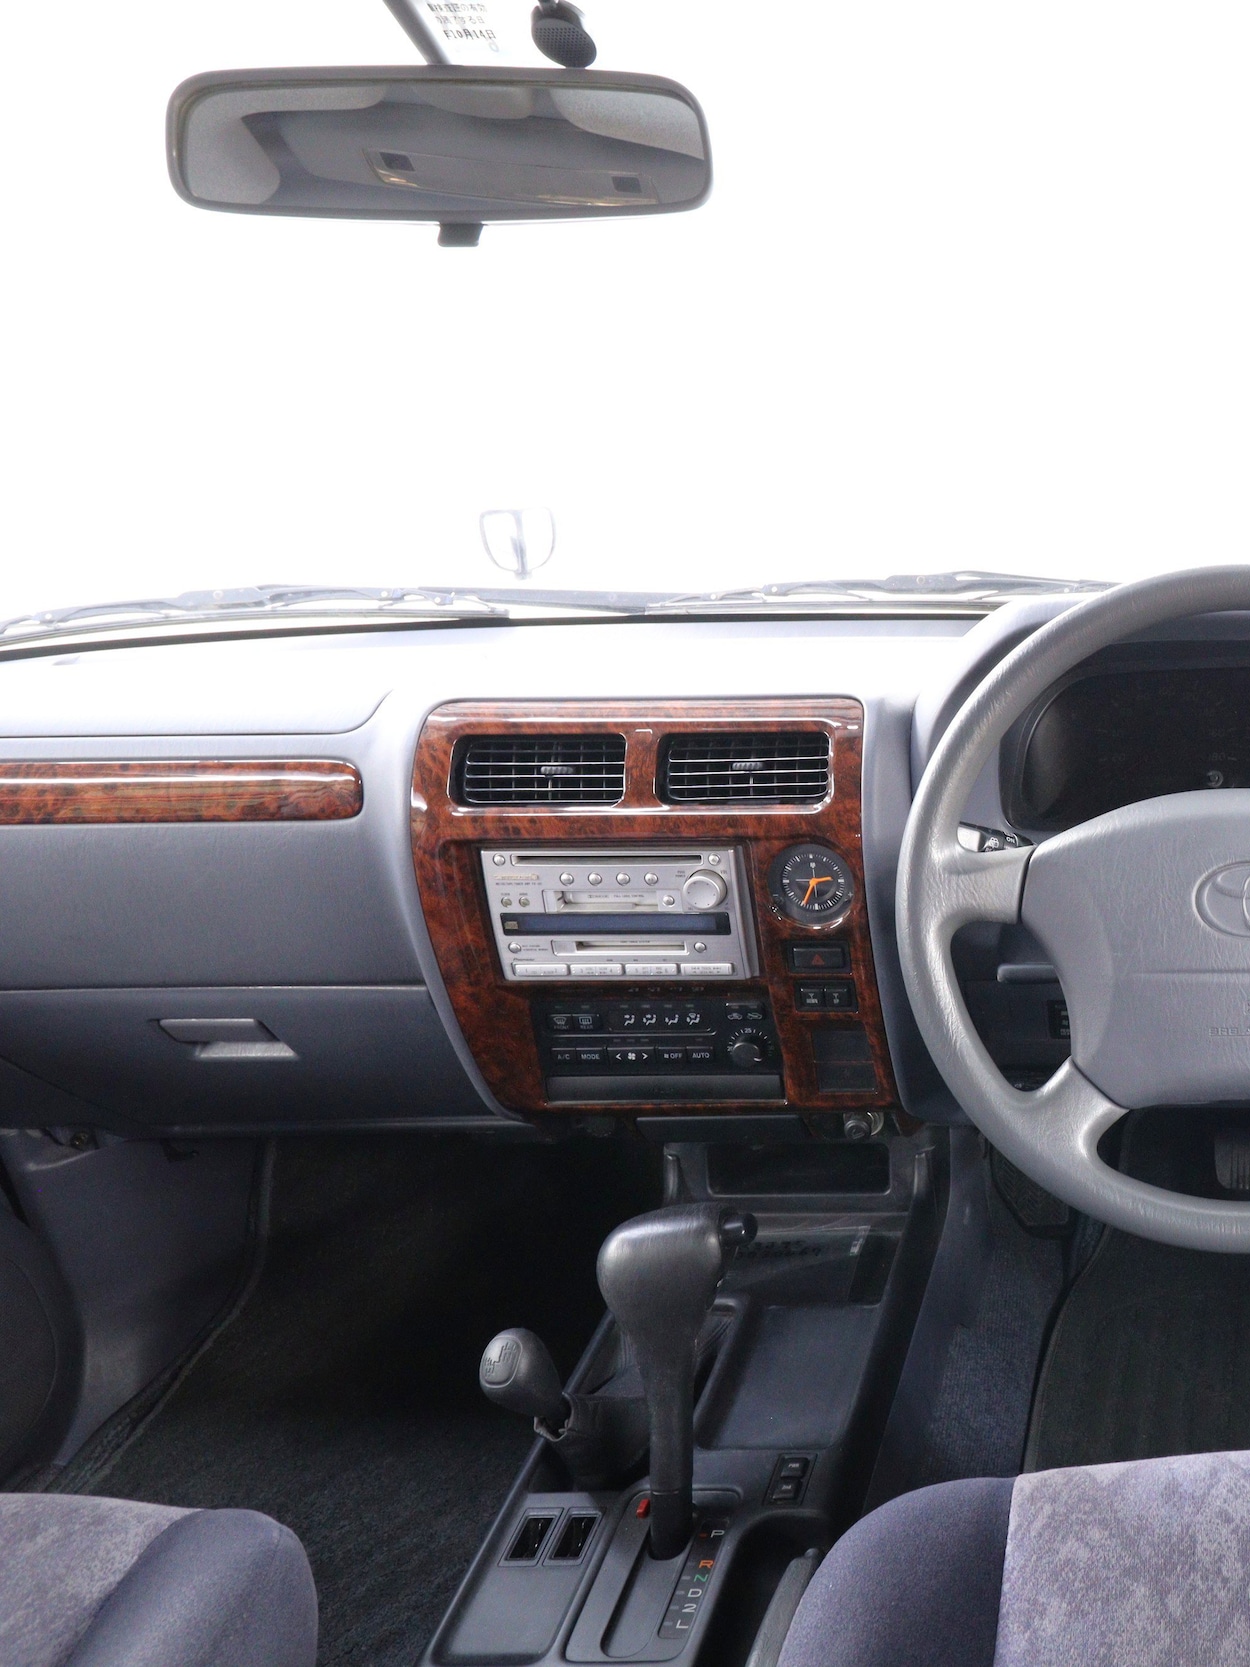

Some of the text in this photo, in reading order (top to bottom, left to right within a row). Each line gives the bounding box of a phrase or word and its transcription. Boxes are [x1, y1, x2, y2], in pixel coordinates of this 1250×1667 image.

[710, 1529, 725, 1538] P
[699, 1560, 714, 1569] R
[694, 1574, 708, 1582] N
[687, 1588, 702, 1598] D
[681, 1603, 697, 1613] 2
[675, 1619, 689, 1629] L
